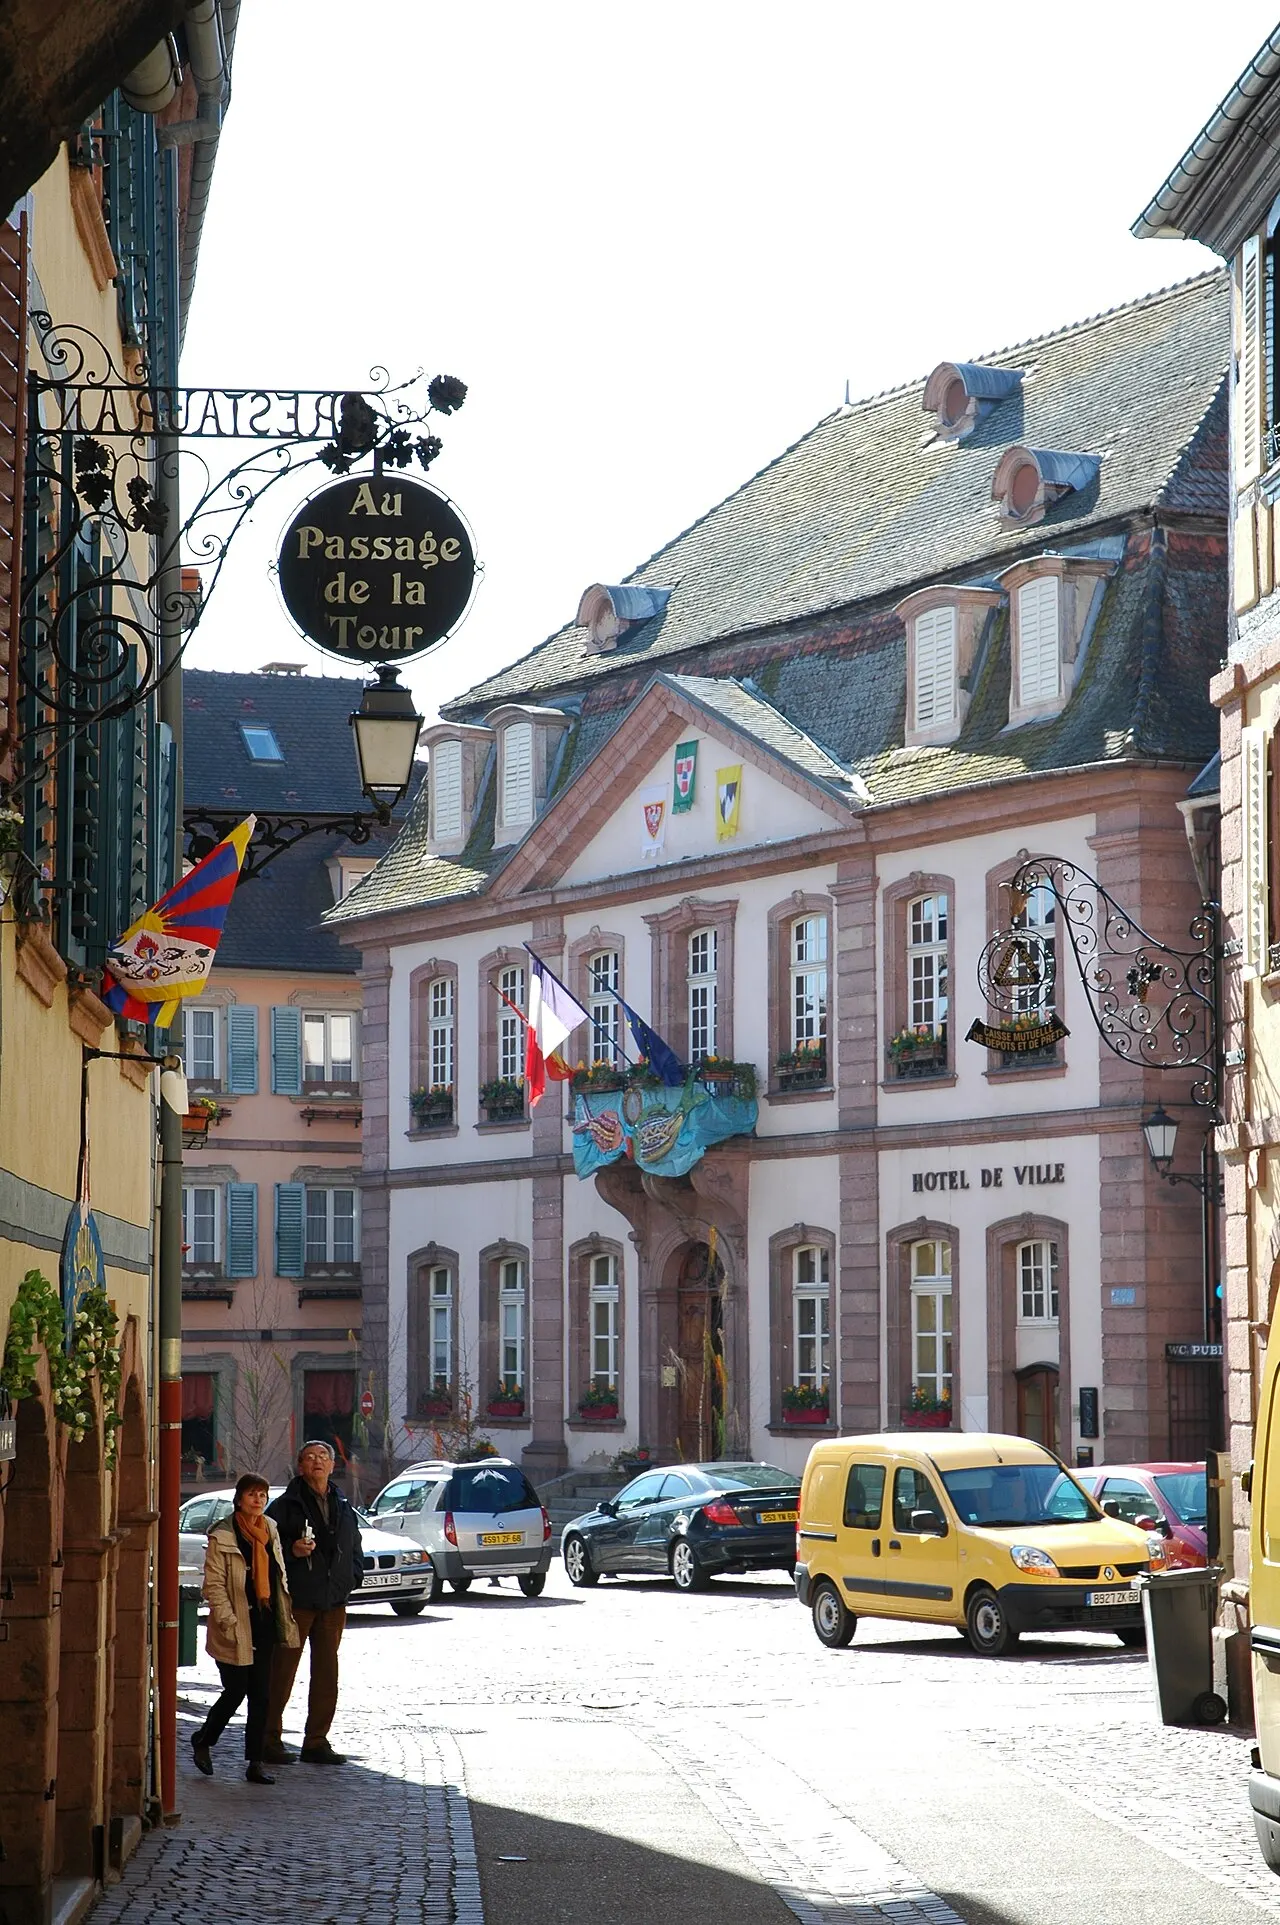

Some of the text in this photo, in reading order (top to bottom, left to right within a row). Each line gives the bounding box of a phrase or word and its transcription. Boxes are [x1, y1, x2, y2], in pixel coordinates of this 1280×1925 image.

[348, 482, 403, 517] Au
[295, 525, 462, 571] Passage
[323, 571, 426, 605] de la
[328, 615, 424, 650] Tour
[973, 1031, 985, 1043] DE
[1017, 1040, 1027, 1051] ET
[1028, 1039, 1039, 1050] DE
[983, 1024, 1054, 1042] CAISSE MUTUELLE
[911, 1162, 1065, 1193] HOTEL DE VILLE
[482, 1534, 522, 1544] 4591 ZF 68
[1093, 1591, 1139, 1604] 8927 ZK 68
